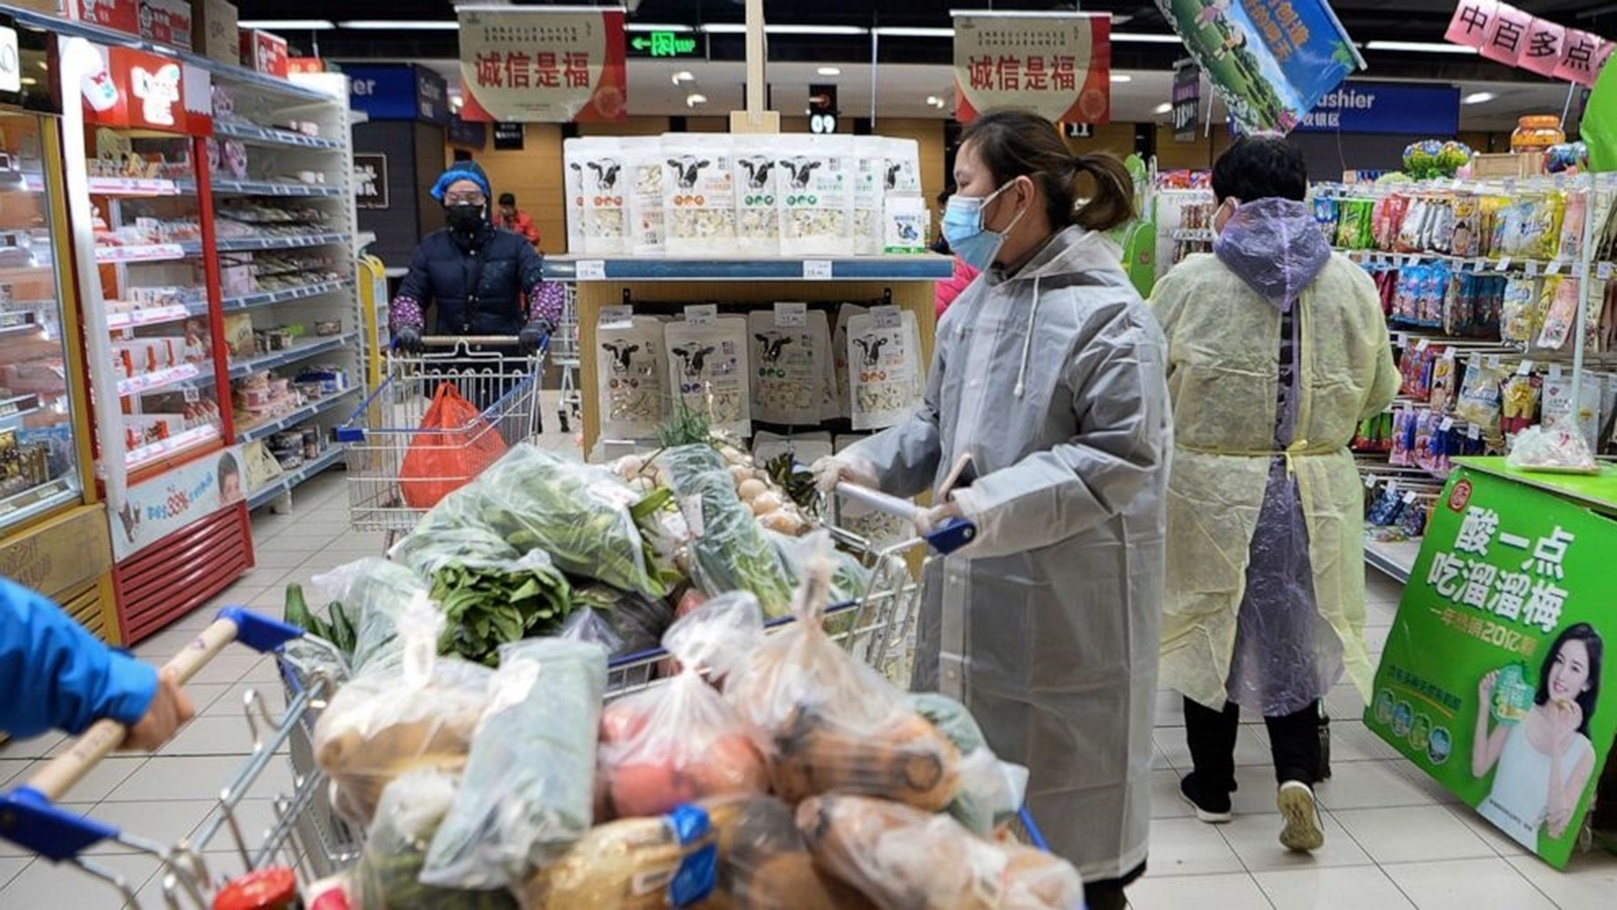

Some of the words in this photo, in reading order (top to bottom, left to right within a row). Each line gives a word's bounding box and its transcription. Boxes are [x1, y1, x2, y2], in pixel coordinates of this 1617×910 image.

[1460, 5, 1605, 72] 中百多点
[475, 51, 590, 89] 诚信是福
[967, 53, 1076, 91] 诚信是福
[1316, 88, 1375, 109] ashier
[811, 114, 835, 133] 09
[1070, 122, 1090, 137] 11
[1454, 504, 1576, 580] 酸一点
[1427, 551, 1569, 633] 吃溜溜梅
